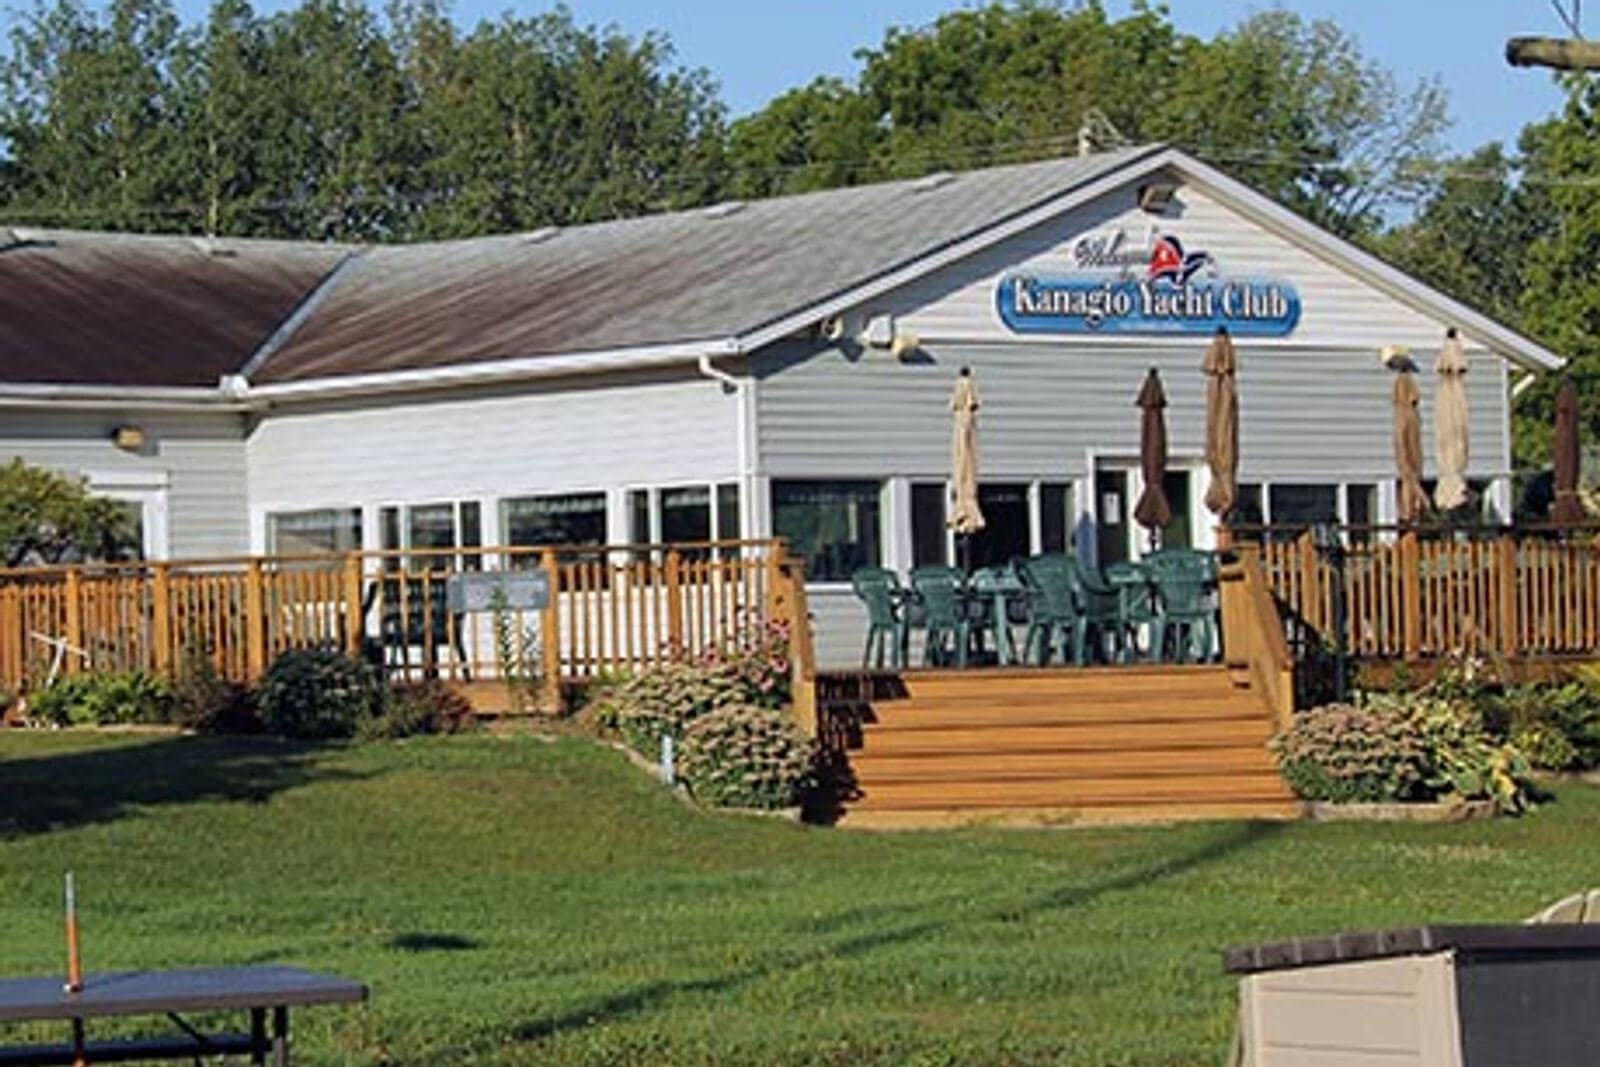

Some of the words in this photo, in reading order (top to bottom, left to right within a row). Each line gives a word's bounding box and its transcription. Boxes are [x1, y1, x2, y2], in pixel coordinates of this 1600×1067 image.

[1013, 279, 1129, 325] Kanagio
[1140, 281, 1212, 316] Yacht
[1222, 283, 1289, 318] Club
